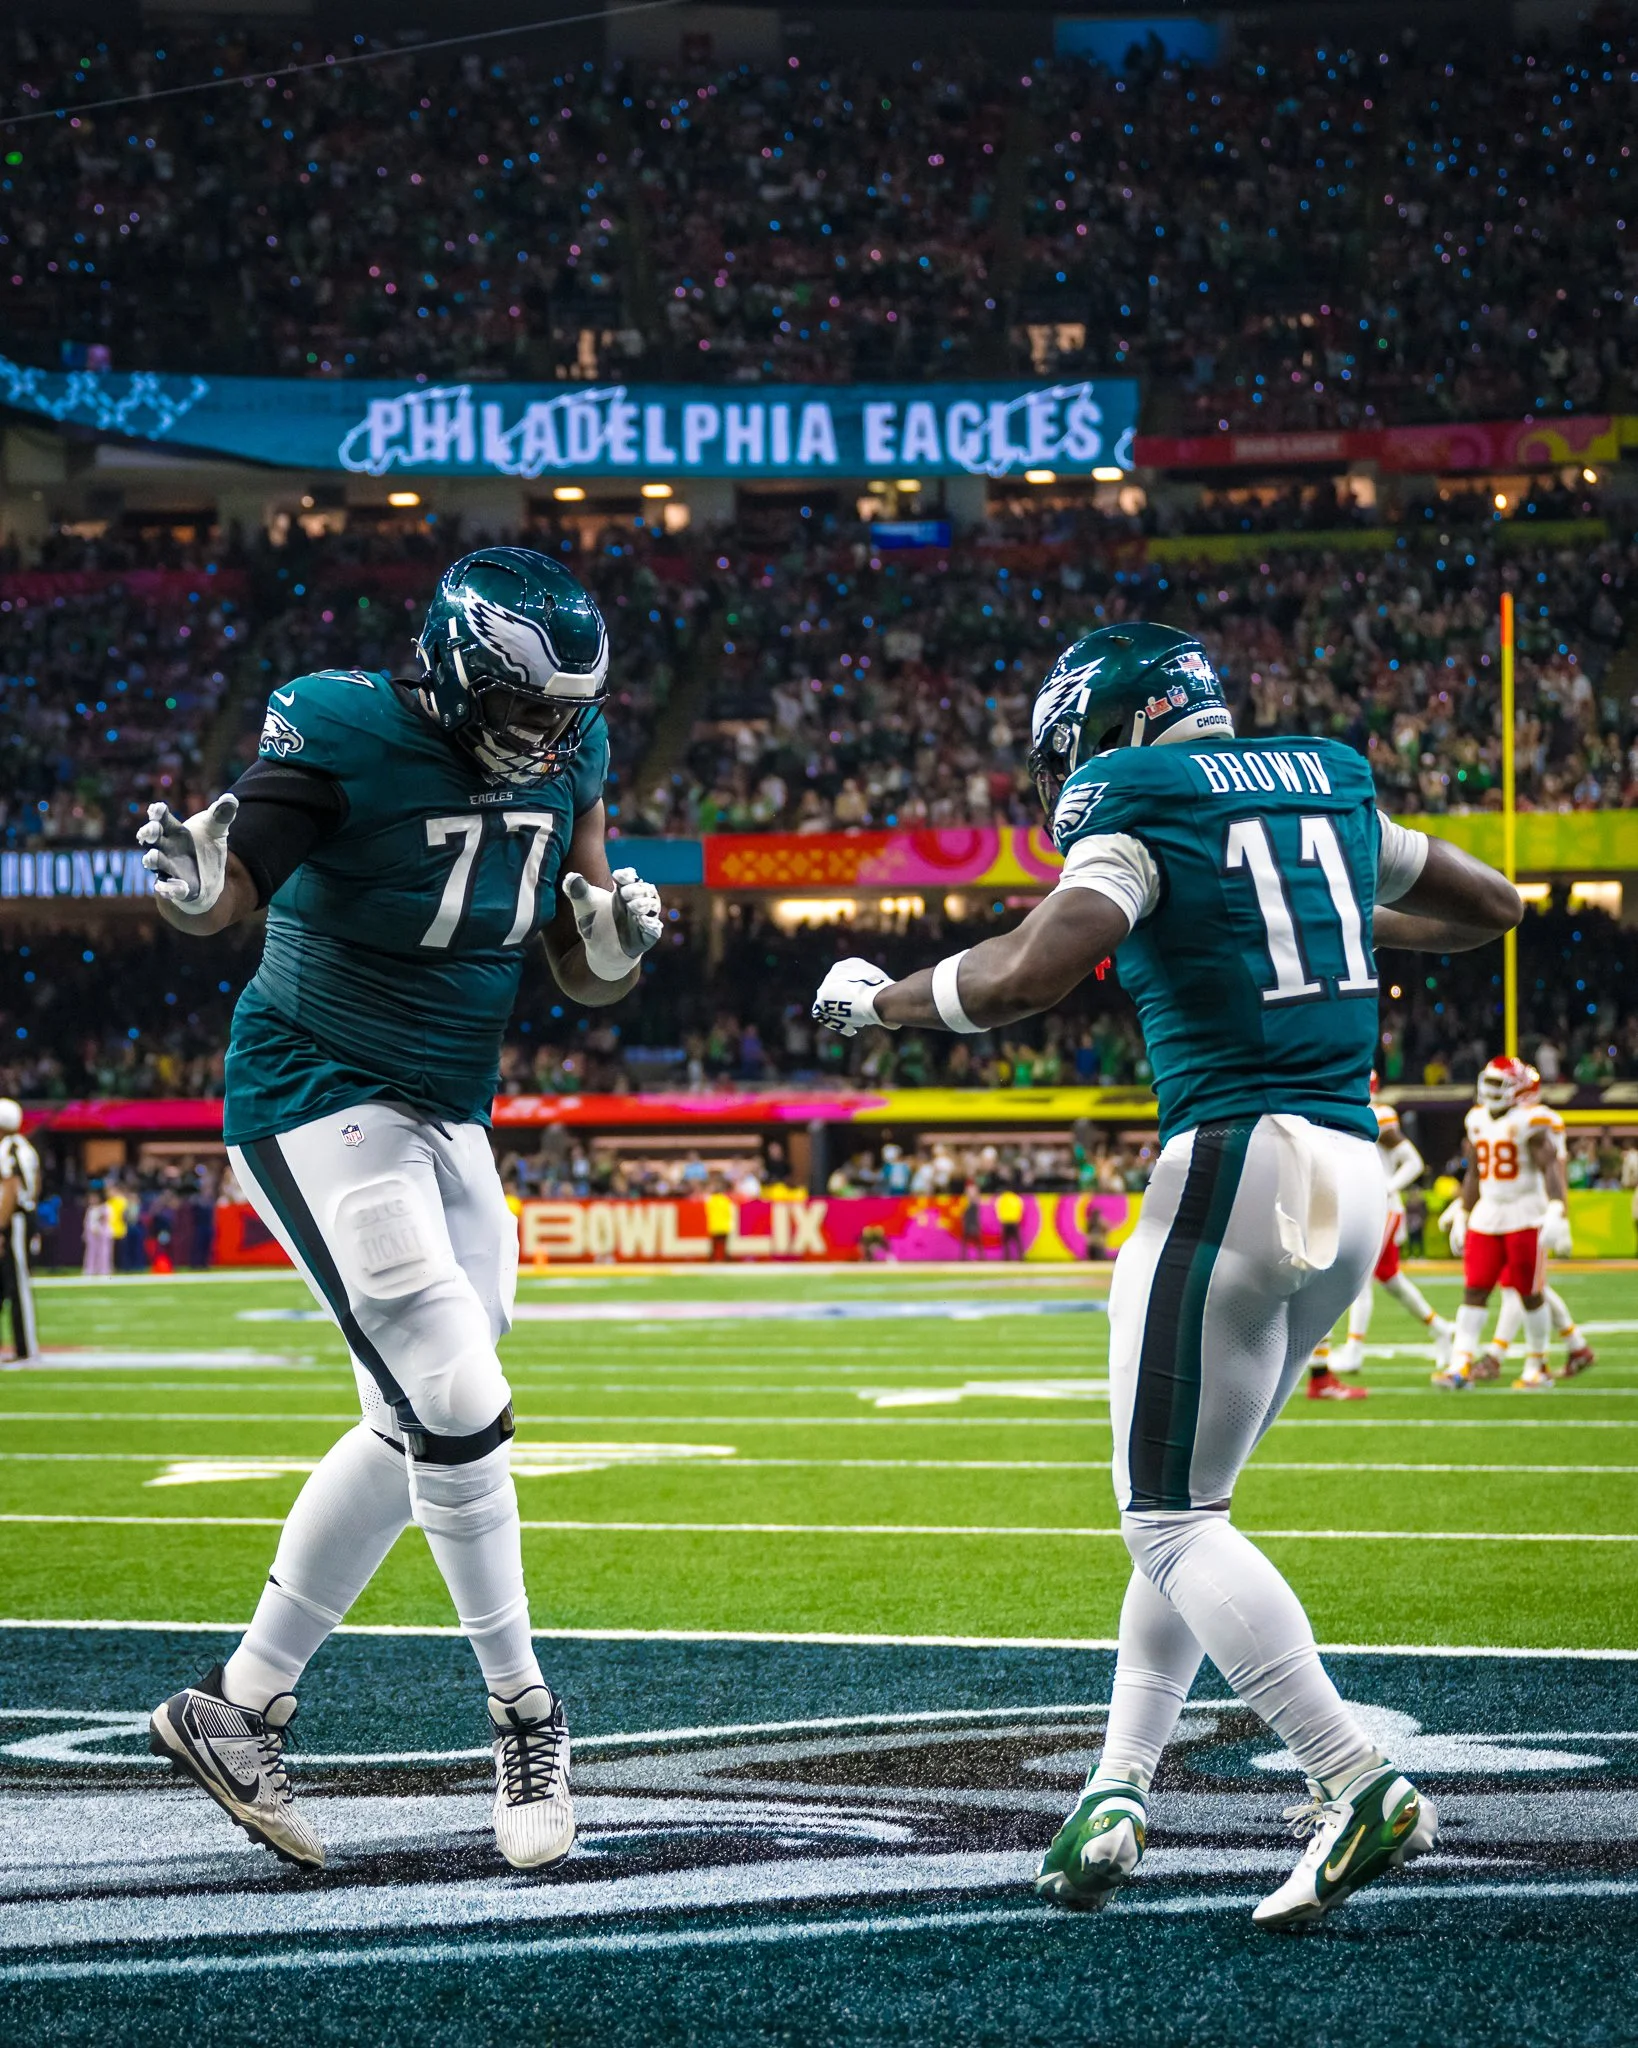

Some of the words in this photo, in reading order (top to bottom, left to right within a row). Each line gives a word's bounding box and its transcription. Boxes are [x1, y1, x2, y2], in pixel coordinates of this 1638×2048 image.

[368, 399, 837, 465] PHILADELPHIA
[863, 400, 1103, 465] EAGLES
[1196, 715, 1228, 728] CHOOSE
[469, 790, 514, 805] EAGLES
[1189, 751, 1332, 795] BROWN
[419, 811, 554, 948] 77
[1224, 815, 1380, 1002] 11
[522, 1202, 710, 1257] BOWL
[726, 1201, 828, 1257] LIX
